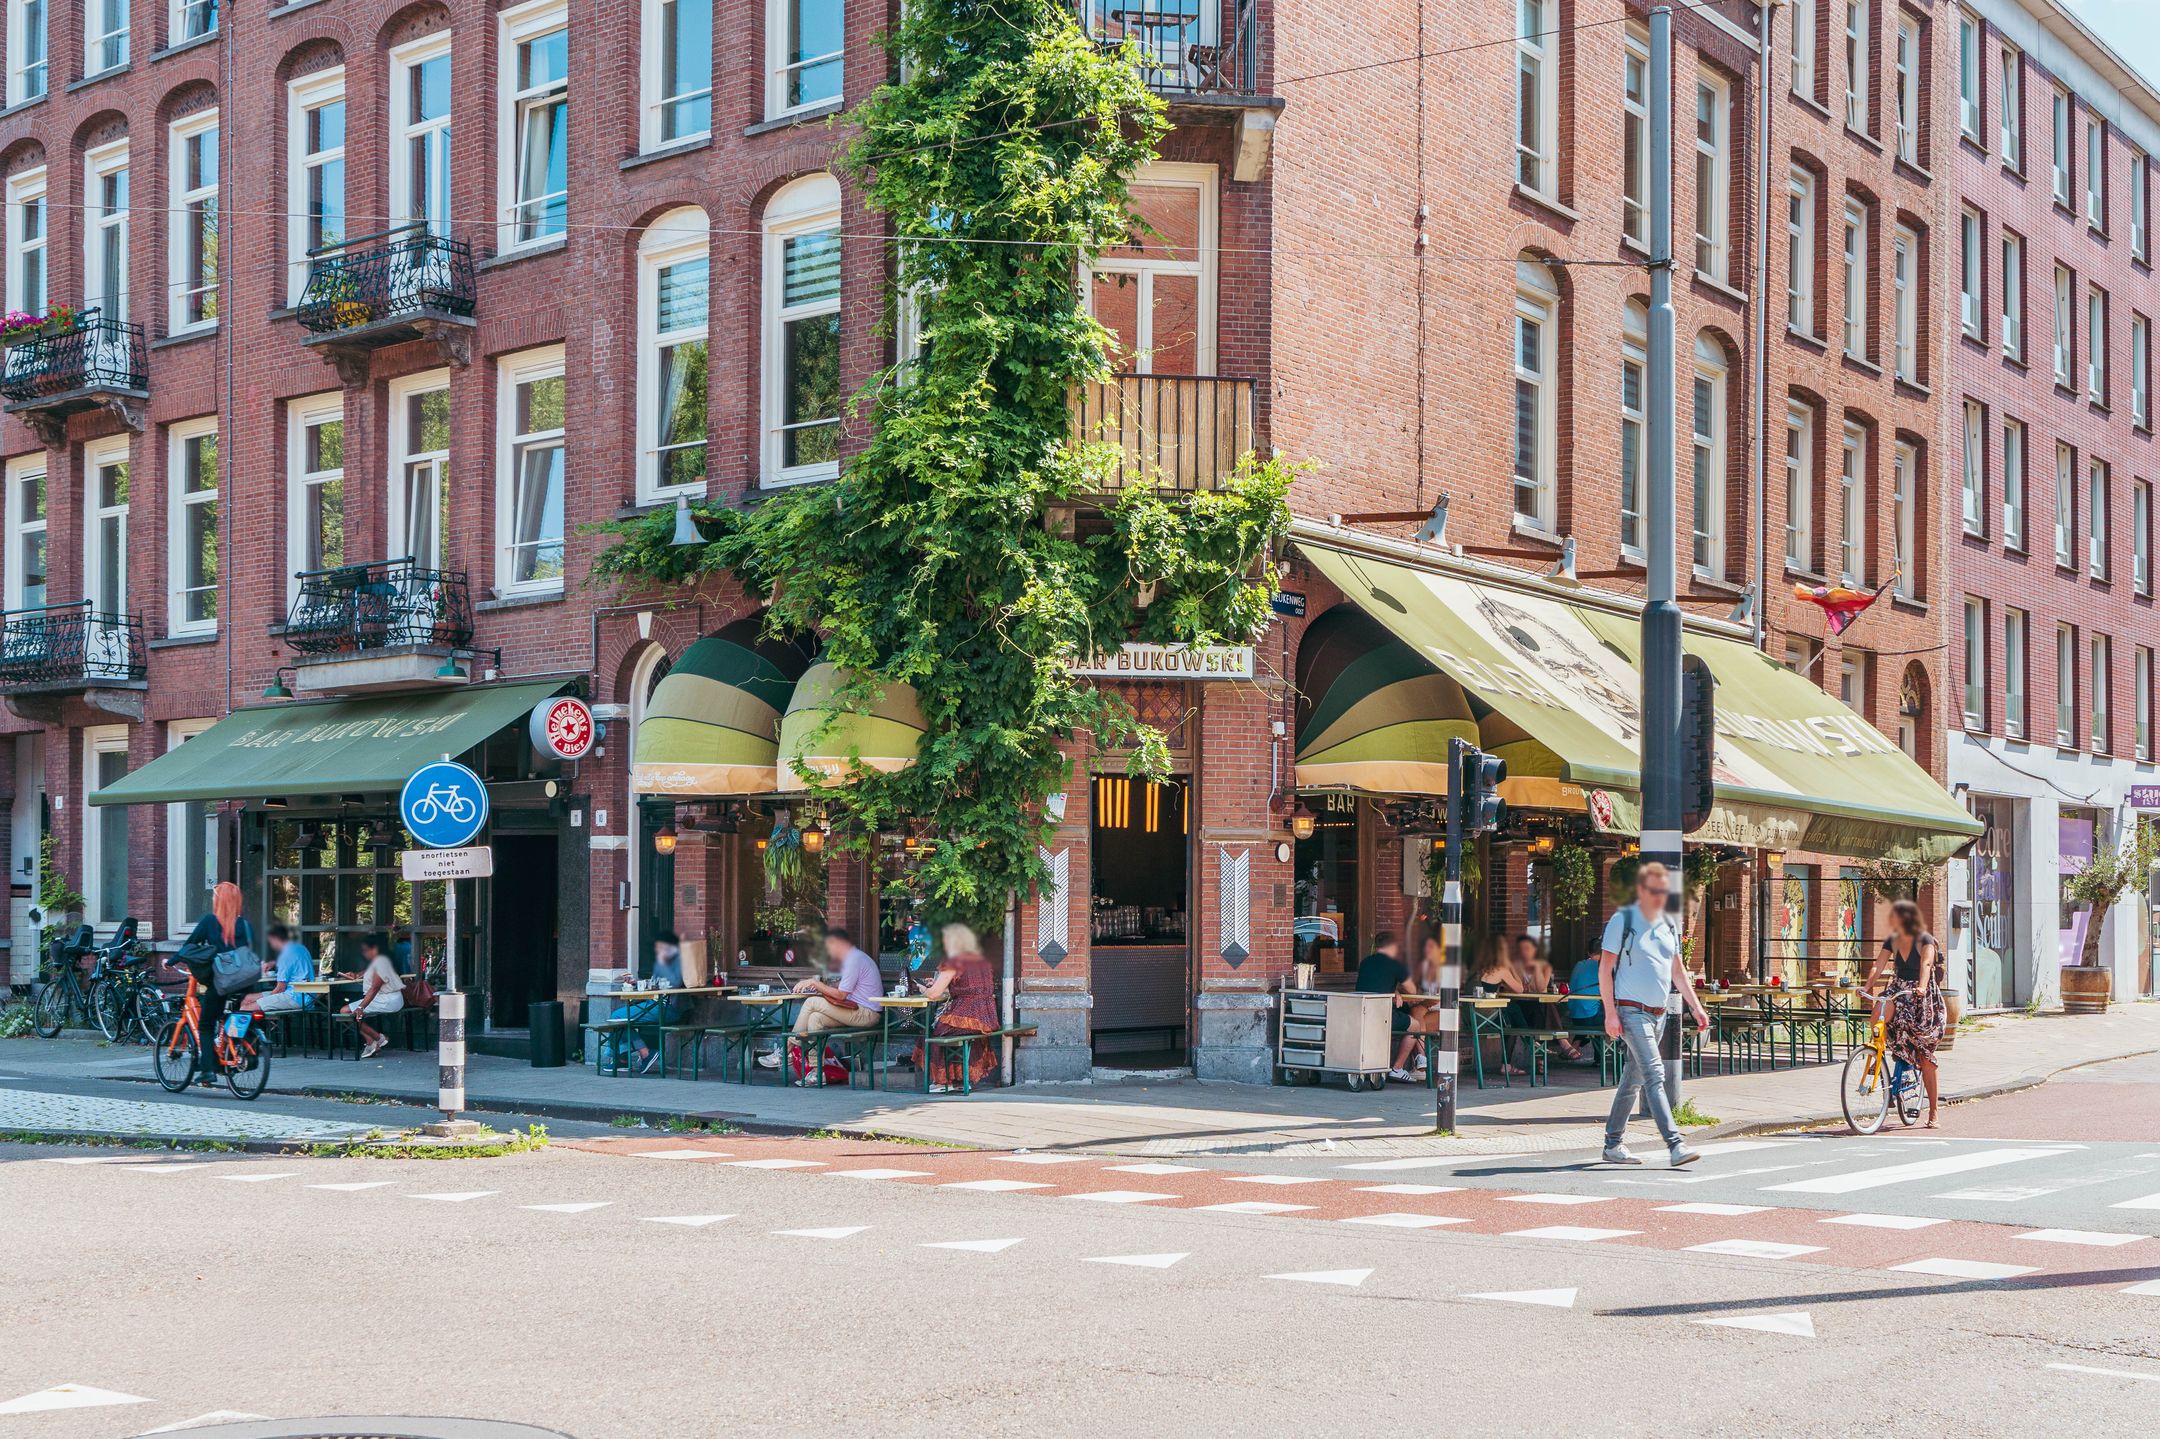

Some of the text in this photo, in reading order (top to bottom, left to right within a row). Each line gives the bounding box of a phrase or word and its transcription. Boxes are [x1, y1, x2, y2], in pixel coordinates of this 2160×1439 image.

[1117, 650, 1243, 672] BUKOWSKI
[1424, 645, 1571, 711] BAR
[229, 712, 468, 748] BAR BUKOWSKI
[563, 739, 585, 753] Bier
[1327, 794, 1355, 813] BAR
[421, 851, 468, 859] snorfietsen
[424, 869, 470, 877] toegestaan
